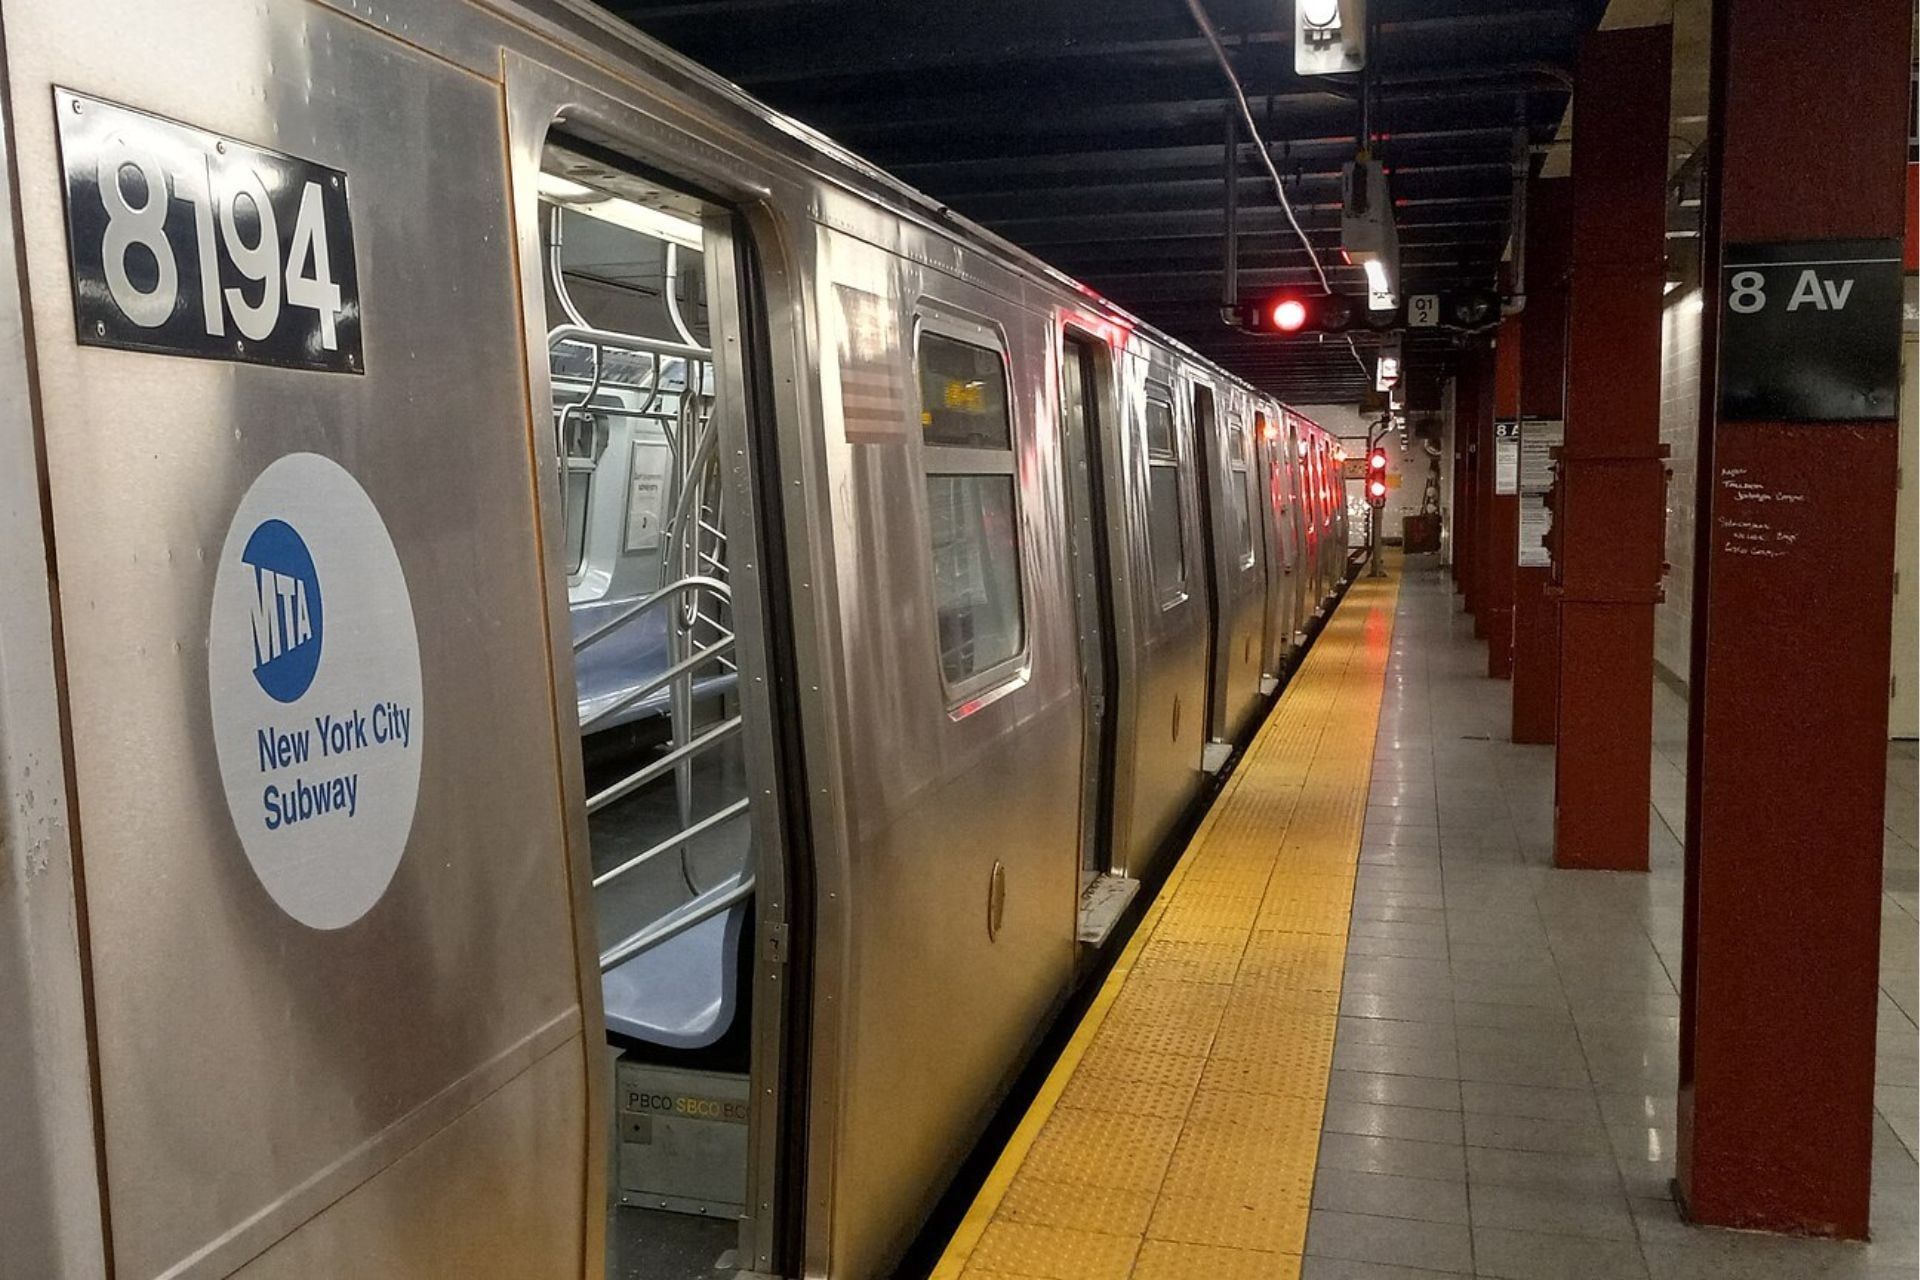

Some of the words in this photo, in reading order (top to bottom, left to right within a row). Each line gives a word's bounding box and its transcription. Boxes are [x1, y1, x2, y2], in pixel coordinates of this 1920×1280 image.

[97, 133, 341, 350] 8194
[1419, 311, 1428, 322] 2
[1728, 271, 1766, 314] 8
[1786, 269, 1854, 312] Av
[1496, 424, 1507, 436] 8
[1511, 424, 1520, 436] A
[243, 562, 313, 669] MTA
[257, 726, 310, 772] New
[315, 709, 368, 758] York
[372, 702, 411, 749] City
[263, 773, 359, 831] Subway
[628, 1092, 673, 1111] PBCO
[676, 1097, 720, 1116] SBCO
